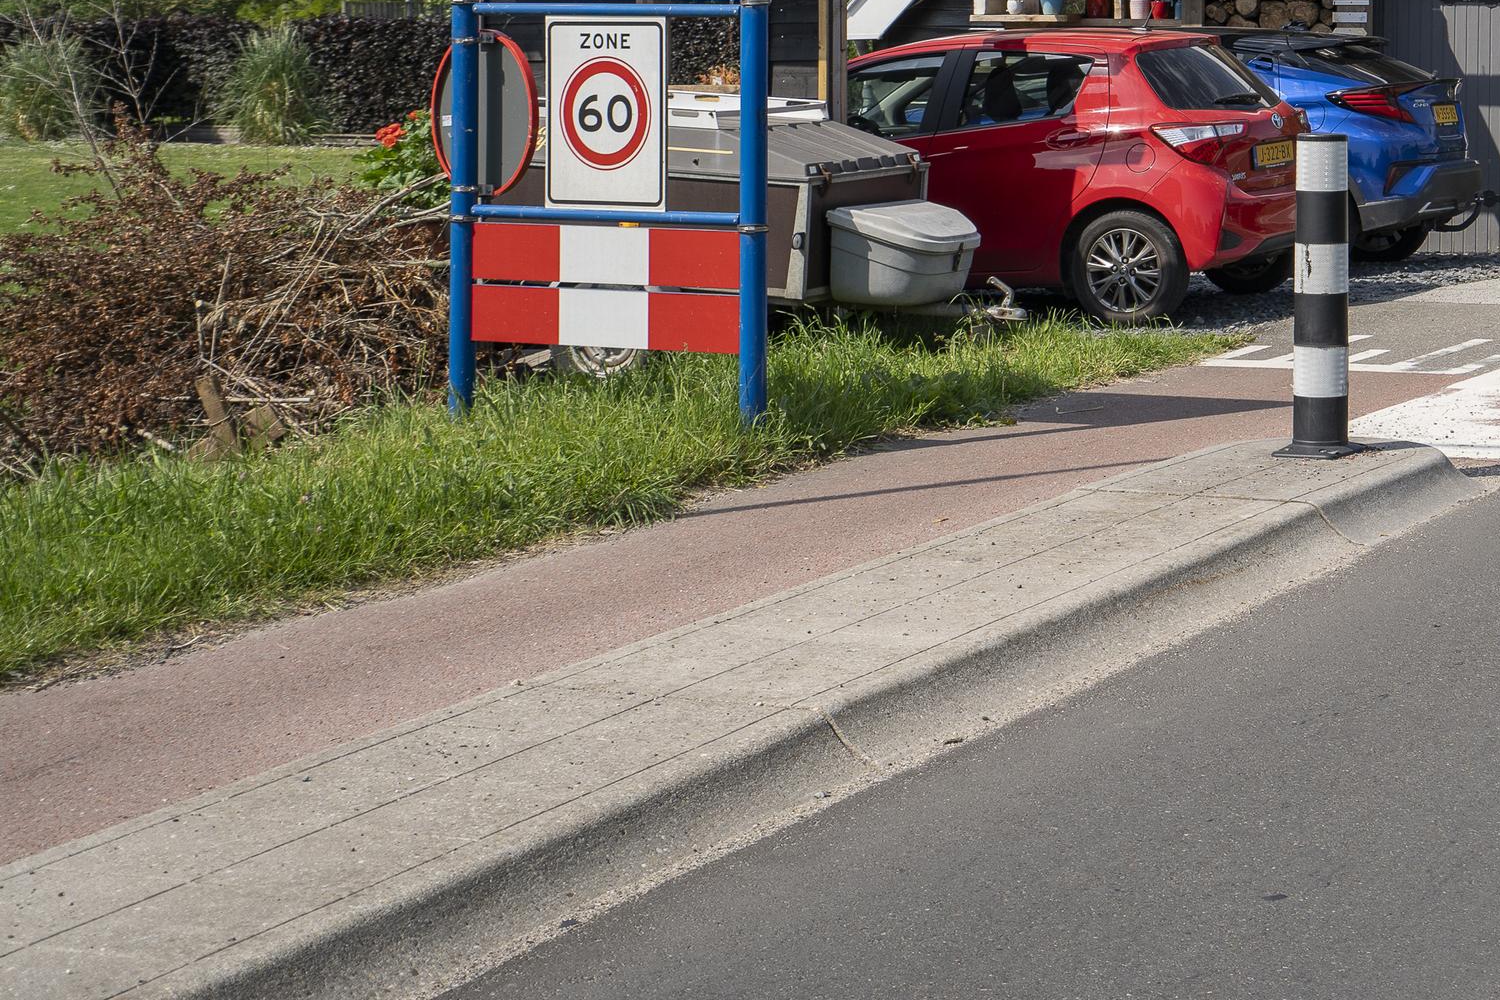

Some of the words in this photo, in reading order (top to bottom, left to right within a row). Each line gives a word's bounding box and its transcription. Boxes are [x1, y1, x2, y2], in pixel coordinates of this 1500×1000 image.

[580, 33, 631, 49] ZONE
[578, 94, 633, 133] 60
[1260, 143, 1291, 162] J-322-BX
